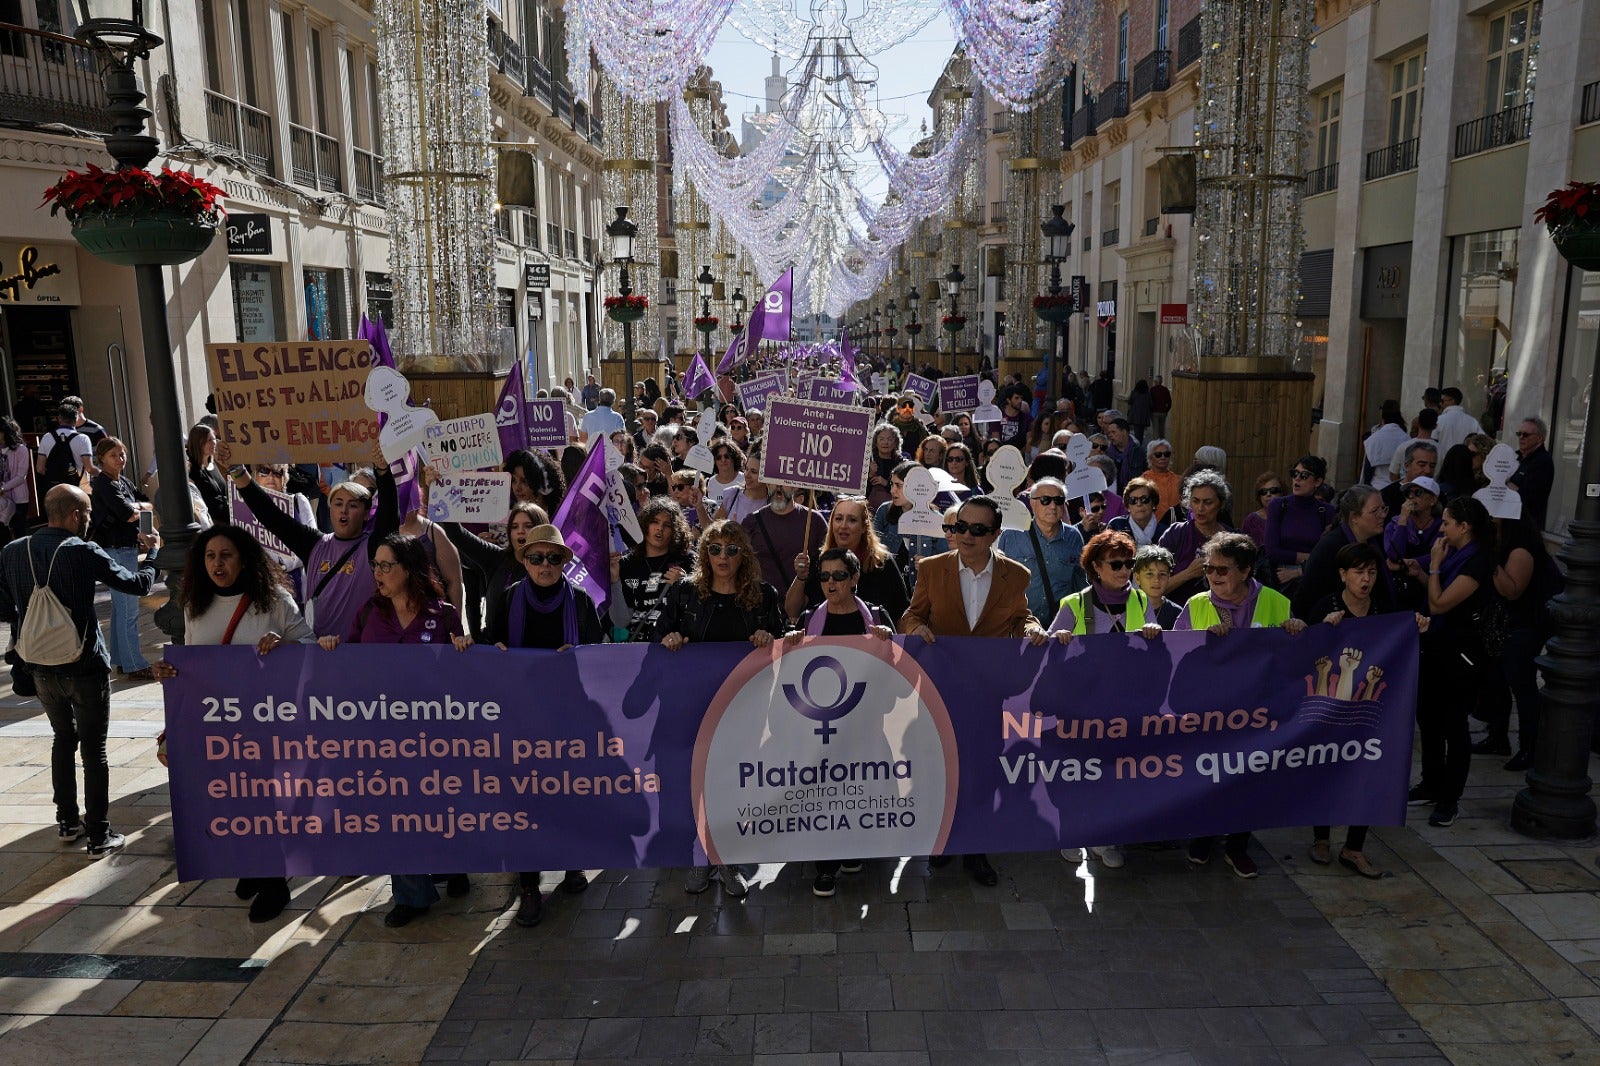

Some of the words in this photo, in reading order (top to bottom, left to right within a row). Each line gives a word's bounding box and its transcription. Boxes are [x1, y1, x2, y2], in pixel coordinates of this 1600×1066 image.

[216, 348, 258, 382] EL
[256, 387, 276, 407] ES
[746, 394, 766, 407] MATA
[532, 404, 553, 421] NO
[802, 408, 825, 419] Ante
[826, 410, 835, 420] la
[223, 419, 251, 446] ES
[426, 425, 444, 439] MI
[446, 417, 485, 434] CUERPO
[774, 416, 815, 430] Violencia
[816, 422, 829, 431] de
[830, 424, 863, 436] Género
[440, 438, 457, 453] NO
[778, 455, 795, 475] TE
[797, 458, 852, 483] CALLES!
[435, 479, 452, 487] NO
[201, 696, 242, 722] 25
[252, 695, 298, 722] de
[309, 694, 501, 721] Noviembre
[1001, 710, 1043, 740] Ni
[1056, 716, 1128, 740] una
[1141, 705, 1279, 737] menos,
[205, 733, 261, 760] Día
[272, 731, 501, 760] Internacional
[512, 737, 586, 765] para
[597, 731, 625, 757] la
[999, 751, 1103, 784] Vivas
[1115, 753, 1184, 780] nos
[1195, 737, 1383, 783] queremos
[207, 768, 409, 799] eliminación
[419, 769, 463, 796] de
[473, 769, 501, 794] la
[510, 767, 661, 796] violencia
[738, 758, 912, 788] Plataforma
[784, 784, 838, 801] contra
[842, 783, 864, 796] las
[737, 799, 823, 818] violencias
[828, 795, 915, 811] machistas
[210, 810, 323, 837] contra
[334, 808, 381, 834] las
[391, 806, 539, 839] mujeres.
[736, 814, 851, 836] VIOLENCIA
[859, 811, 916, 830] CERO
